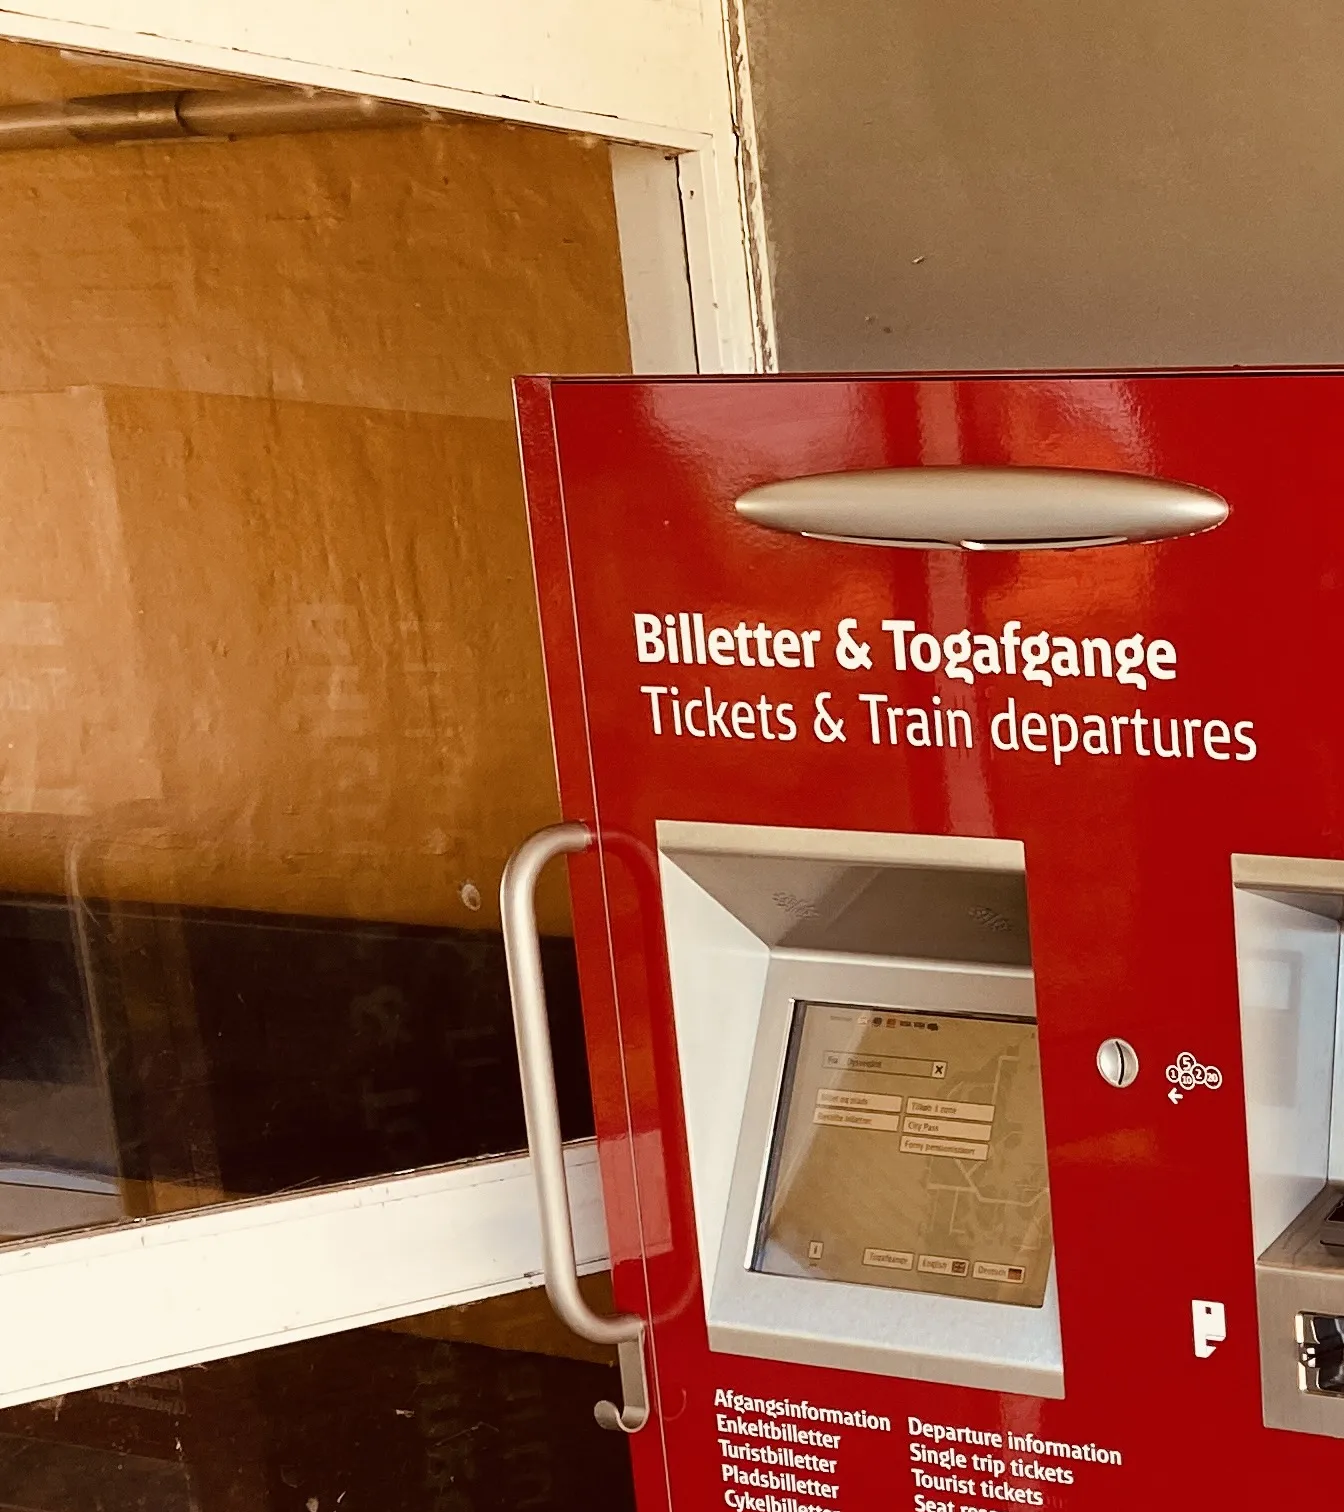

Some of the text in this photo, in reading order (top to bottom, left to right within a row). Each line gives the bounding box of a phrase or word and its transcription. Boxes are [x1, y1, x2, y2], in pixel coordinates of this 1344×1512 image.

[634, 612, 1177, 691] Billetter & Togafgange
[640, 685, 1257, 766] Tickets & Train departures
[1182, 1056, 1192, 1071] 5
[714, 1388, 892, 1432] Afgangsinformation
[716, 1413, 841, 1449] Enkeltbilletter
[907, 1416, 1123, 1466] Departure information
[717, 1438, 838, 1474] Turistbilletter
[909, 1442, 1075, 1485] Single trip tickets
[721, 1463, 840, 1499] Pladsbilletter
[911, 1468, 1044, 1506] Tourist tickets
